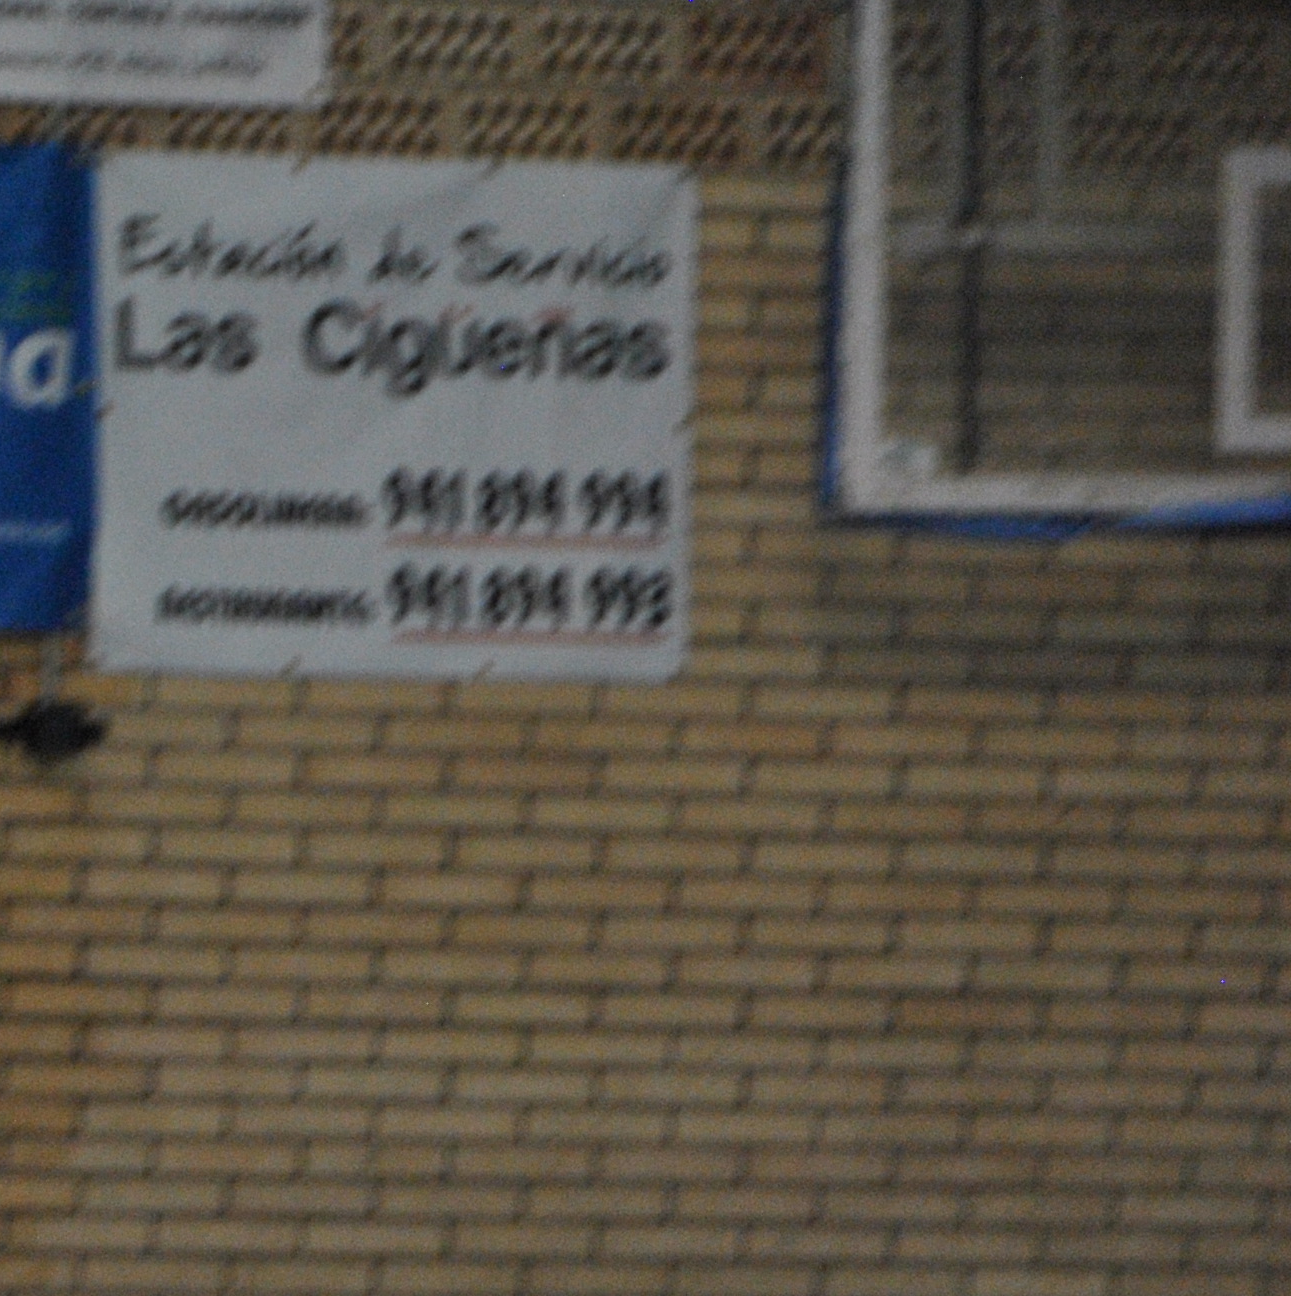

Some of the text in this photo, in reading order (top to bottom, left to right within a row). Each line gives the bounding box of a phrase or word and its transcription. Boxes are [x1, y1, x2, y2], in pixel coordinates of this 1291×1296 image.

[367, 228, 439, 284] de
[455, 222, 671, 288] Servicio
[115, 300, 669, 398] Las Cigüeñas
